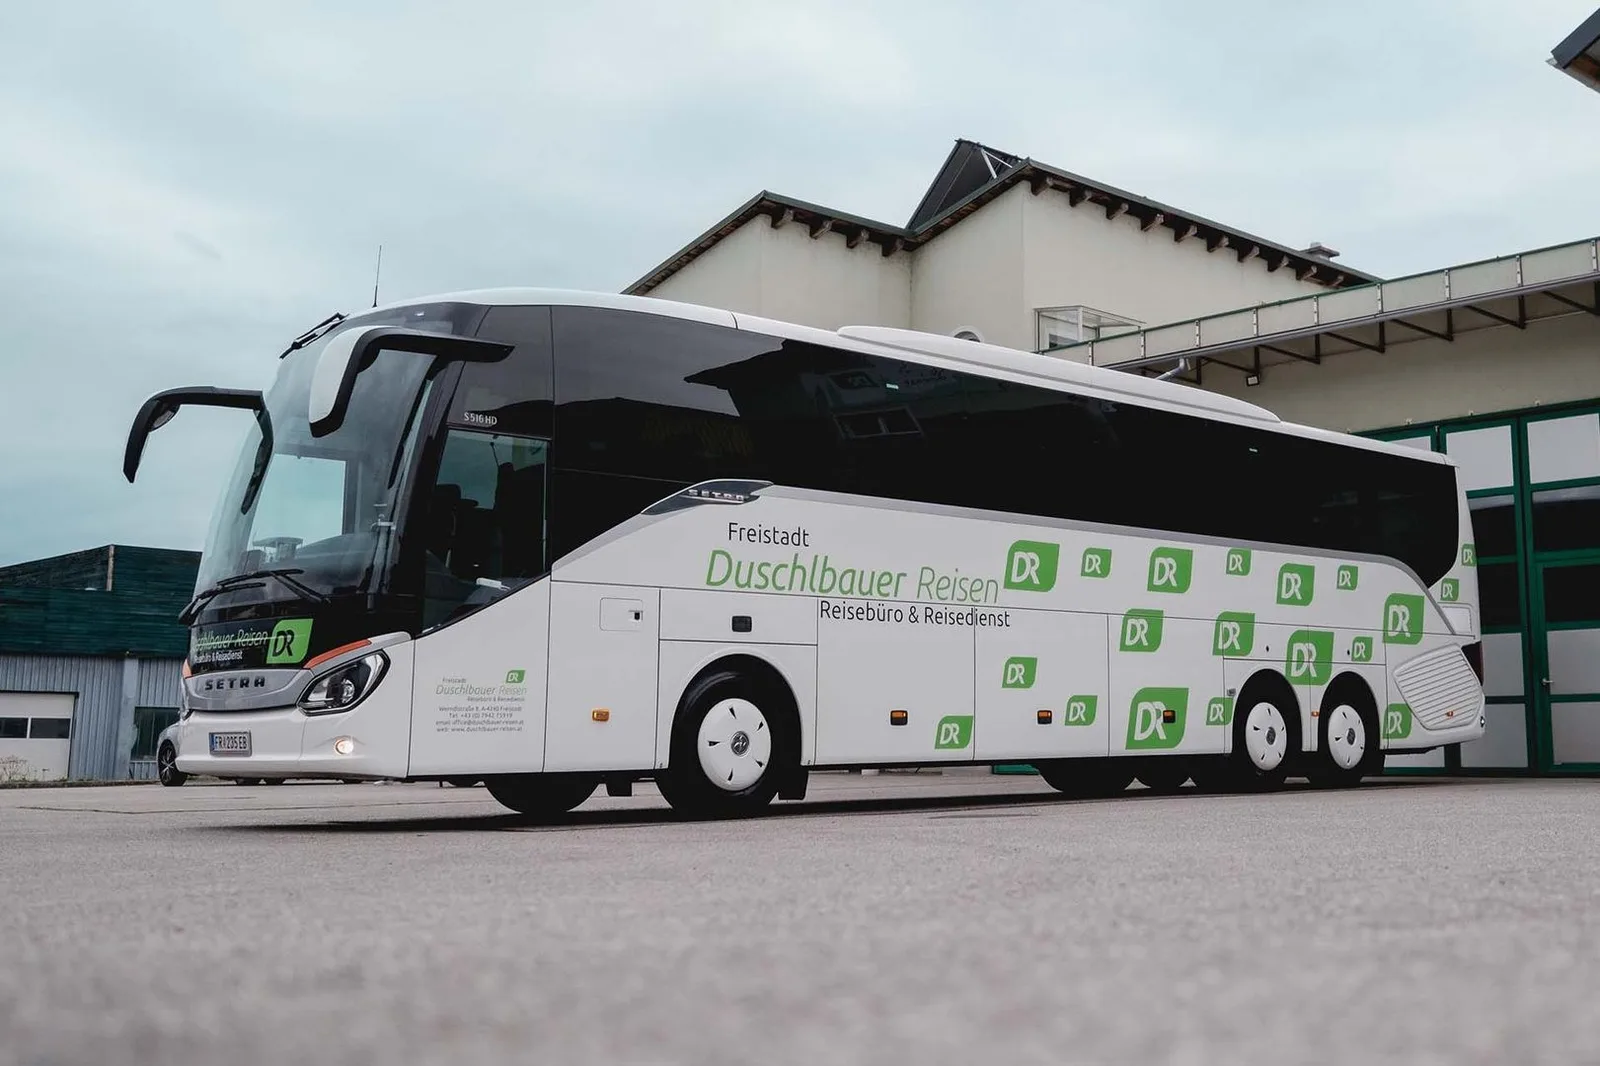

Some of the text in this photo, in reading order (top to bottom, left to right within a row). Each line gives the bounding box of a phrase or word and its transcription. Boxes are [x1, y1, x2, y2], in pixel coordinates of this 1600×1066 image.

[728, 522, 810, 547] Freistadt
[1084, 554, 1101, 574] DR
[1229, 553, 1243, 572] DR
[1463, 548, 1473, 564] DR
[705, 549, 999, 603] Duschlbauer Reisen
[1010, 551, 1040, 585] DR
[1152, 556, 1178, 587] DR
[1338, 569, 1351, 587] DR
[1281, 572, 1303, 600] DR
[1442, 583, 1453, 598] DR
[820, 600, 1011, 628] Reisebüro & Reisedienst
[1387, 604, 1411, 637] DR
[234, 628, 268, 647] Reisen
[272, 629, 295, 657] DR
[1125, 617, 1149, 646] DR
[1218, 621, 1241, 650] DR
[1290, 643, 1317, 678] DR
[1353, 642, 1366, 658] DR
[205, 676, 266, 691] SETRA
[1006, 663, 1025, 684] DR
[435, 684, 527, 695] Duschlbauer Reisen
[1068, 701, 1086, 722] DR
[1133, 701, 1167, 741] DR
[1208, 703, 1224, 722] DR
[1386, 711, 1402, 733] DR
[939, 722, 960, 745] DR
